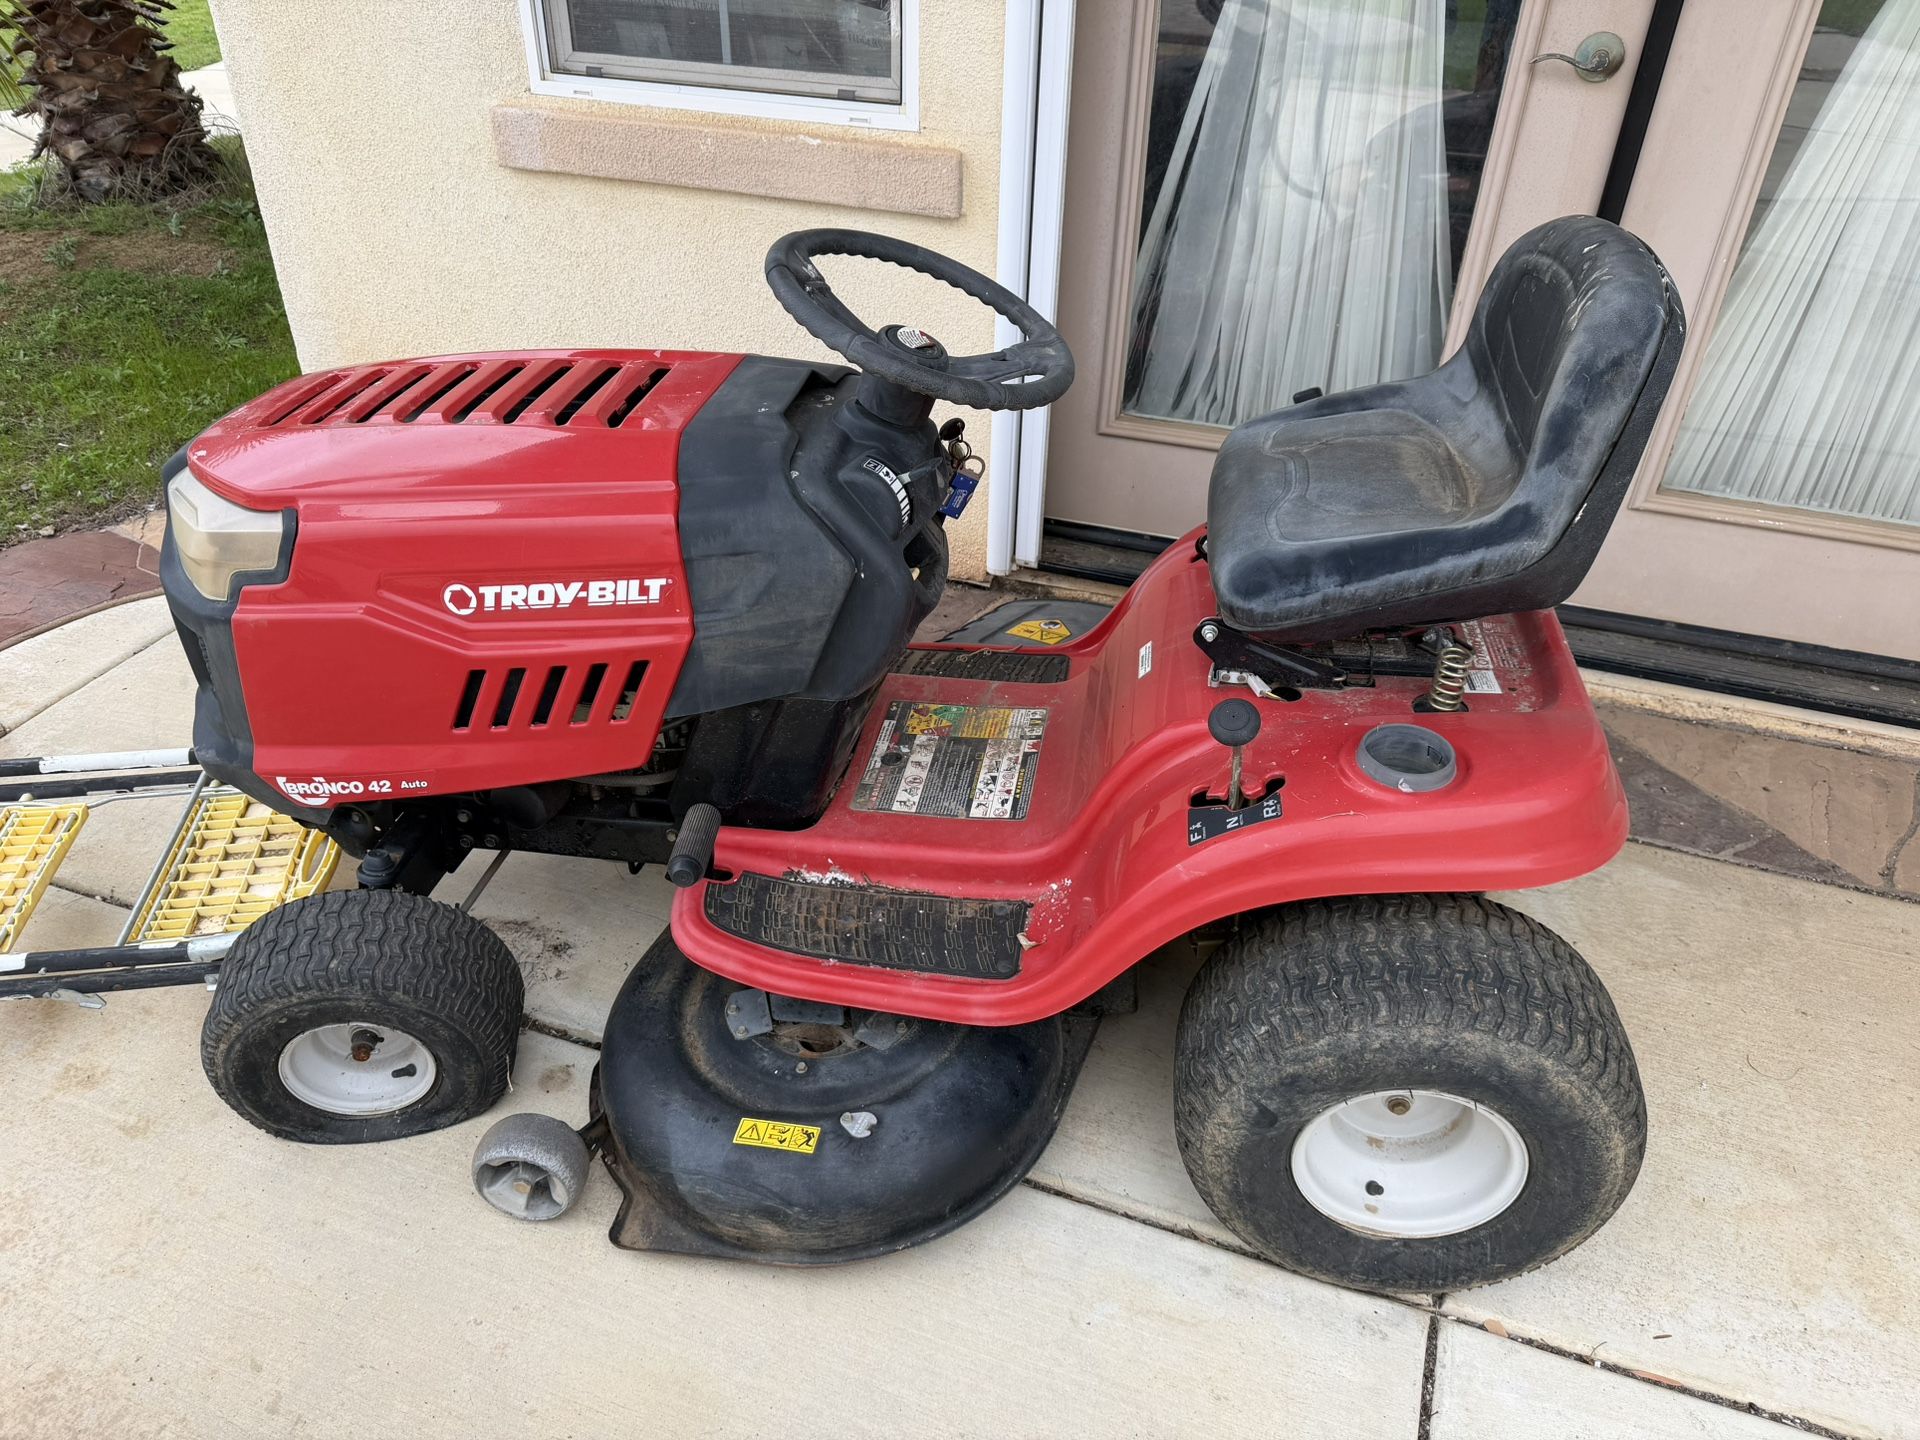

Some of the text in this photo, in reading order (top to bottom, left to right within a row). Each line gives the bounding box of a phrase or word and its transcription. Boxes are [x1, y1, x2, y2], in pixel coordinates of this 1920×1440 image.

[479, 578, 667, 611] TROY-BILT
[285, 779, 428, 795] BRONCO 42 Auto
[1263, 805, 1277, 819] R
[1226, 816, 1239, 829] N
[1190, 833, 1202, 843] F
